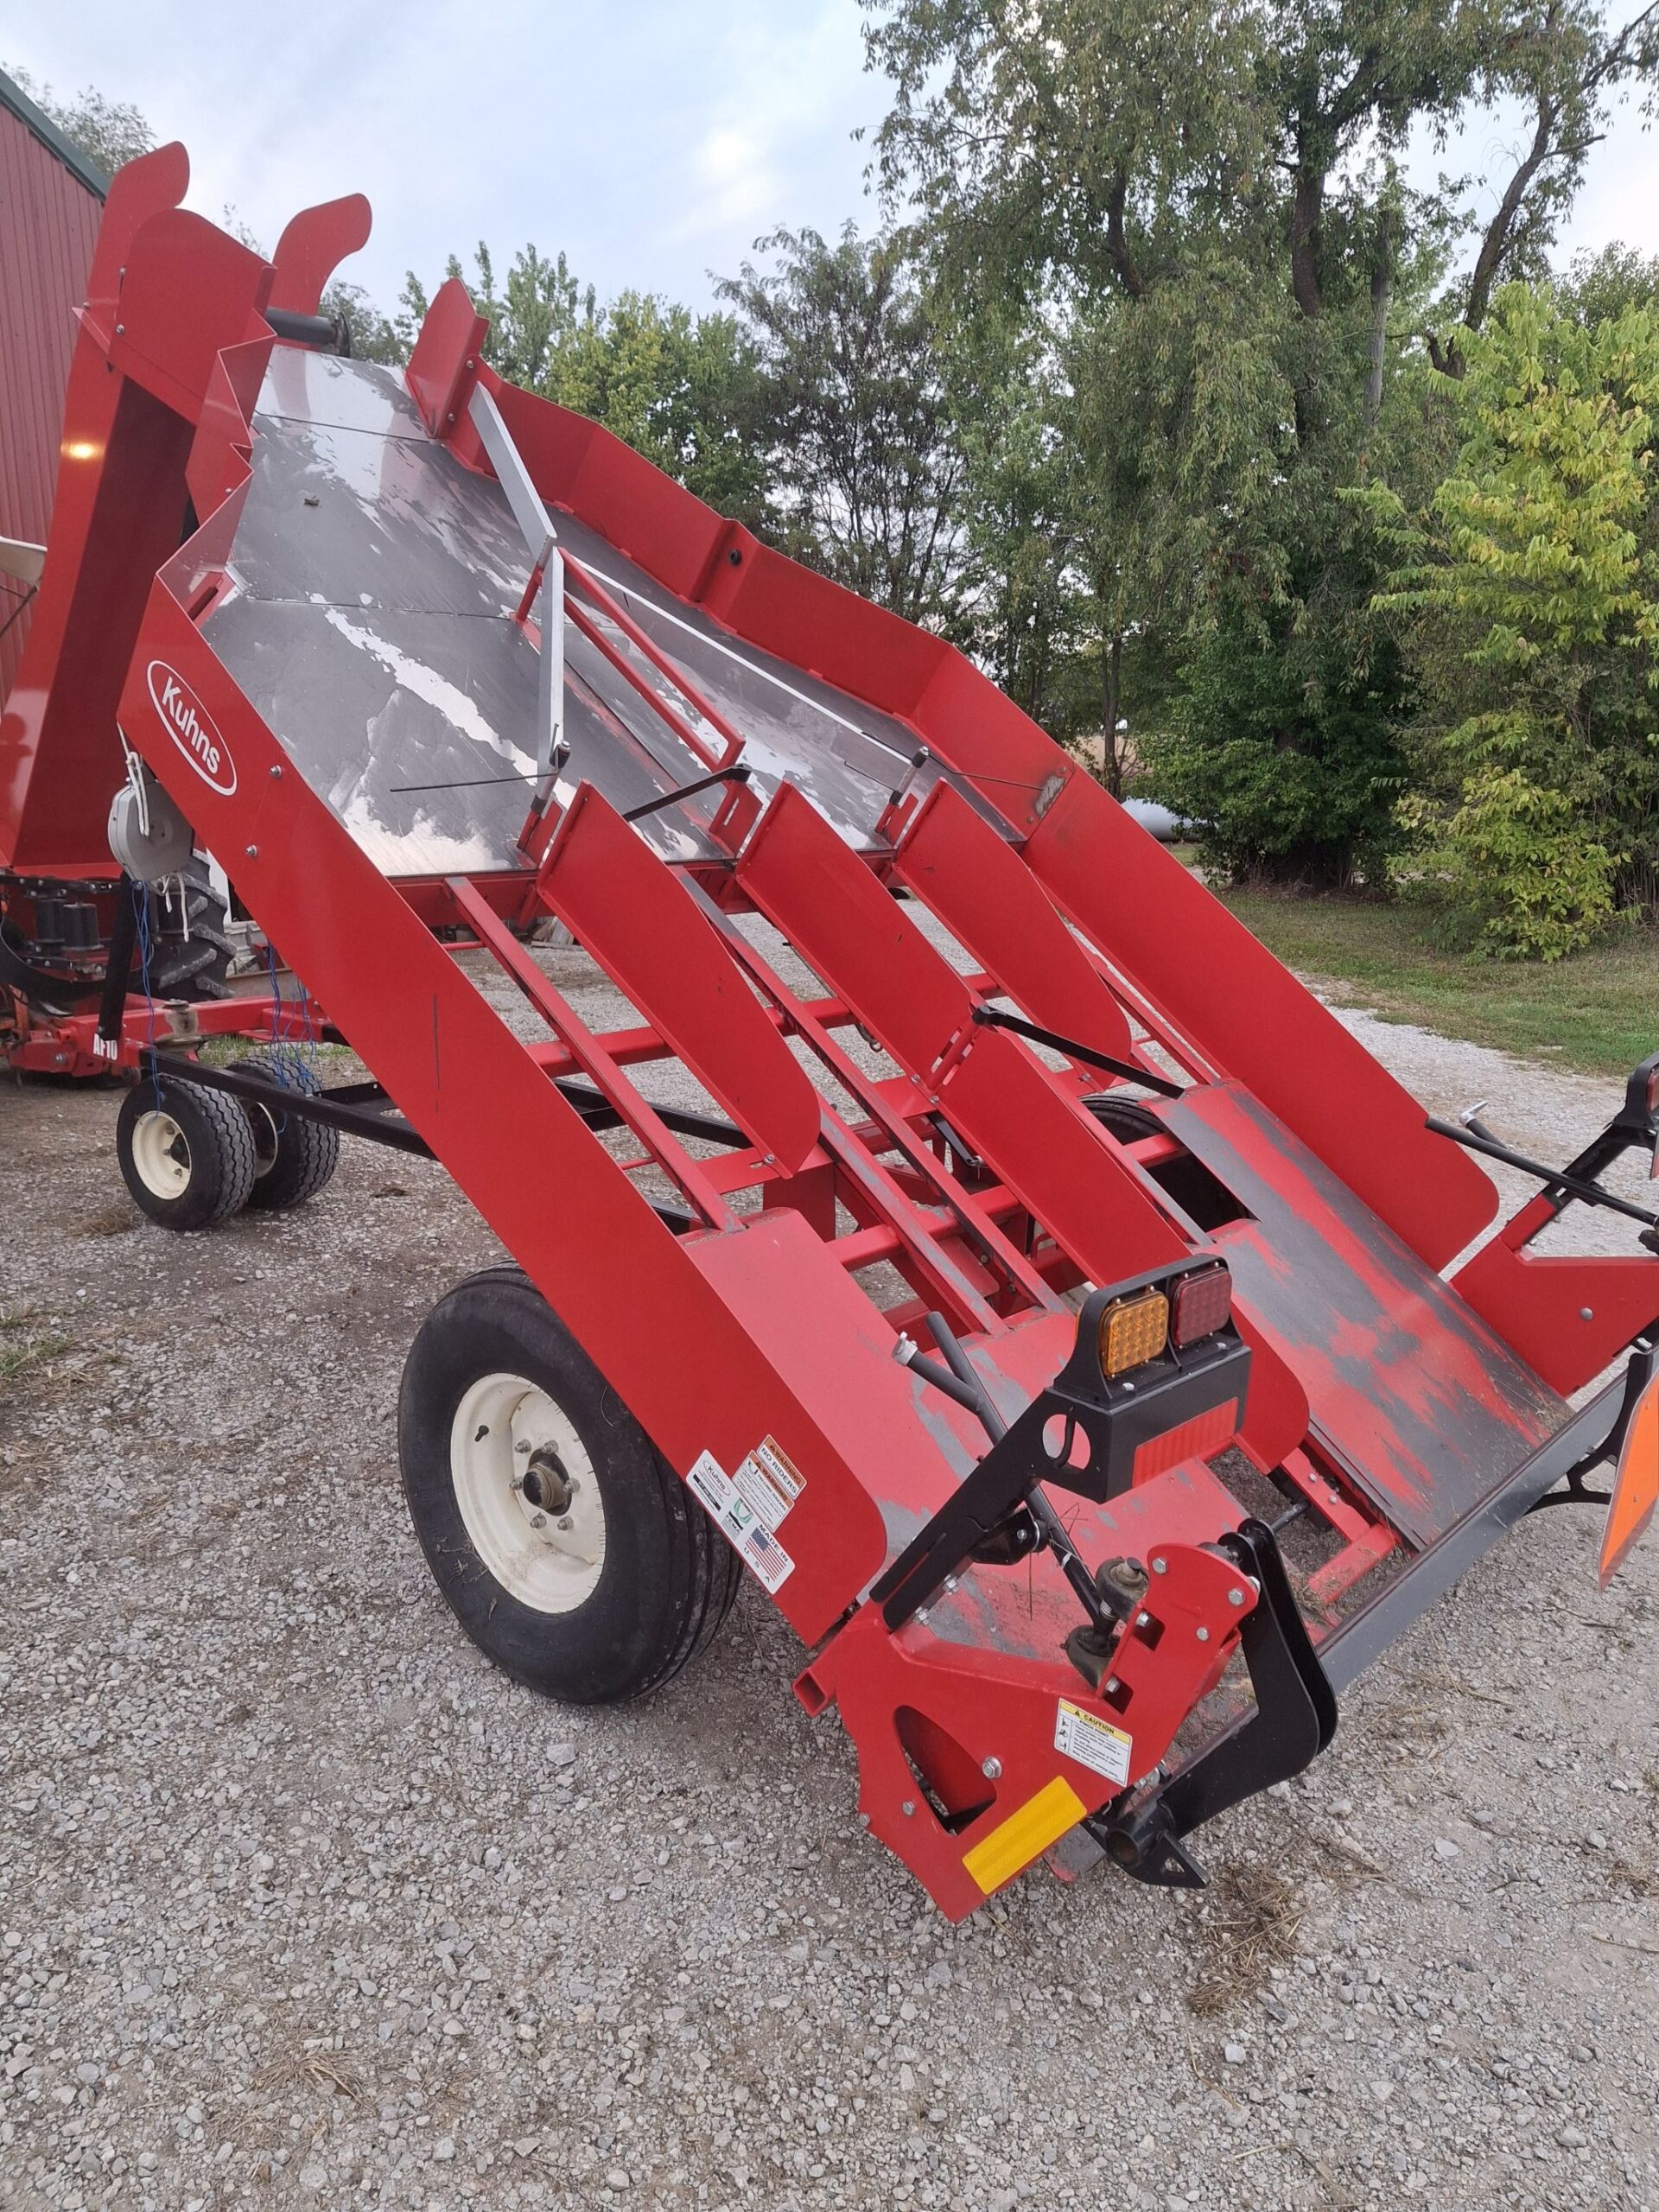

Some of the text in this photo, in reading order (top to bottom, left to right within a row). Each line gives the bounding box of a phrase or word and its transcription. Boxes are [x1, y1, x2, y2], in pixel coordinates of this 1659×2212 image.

[162, 676, 220, 774] Kuhns
[708, 1465, 726, 1490] Kuhns
[760, 1447, 772, 1461] NO
[772, 1461, 797, 1493] RIDERS
[761, 1467, 787, 1501] WARNING
[774, 1449, 802, 1484] WARNING
[759, 1523, 788, 1562] MADE IN
[1084, 1713, 1114, 1734] CAUTION
